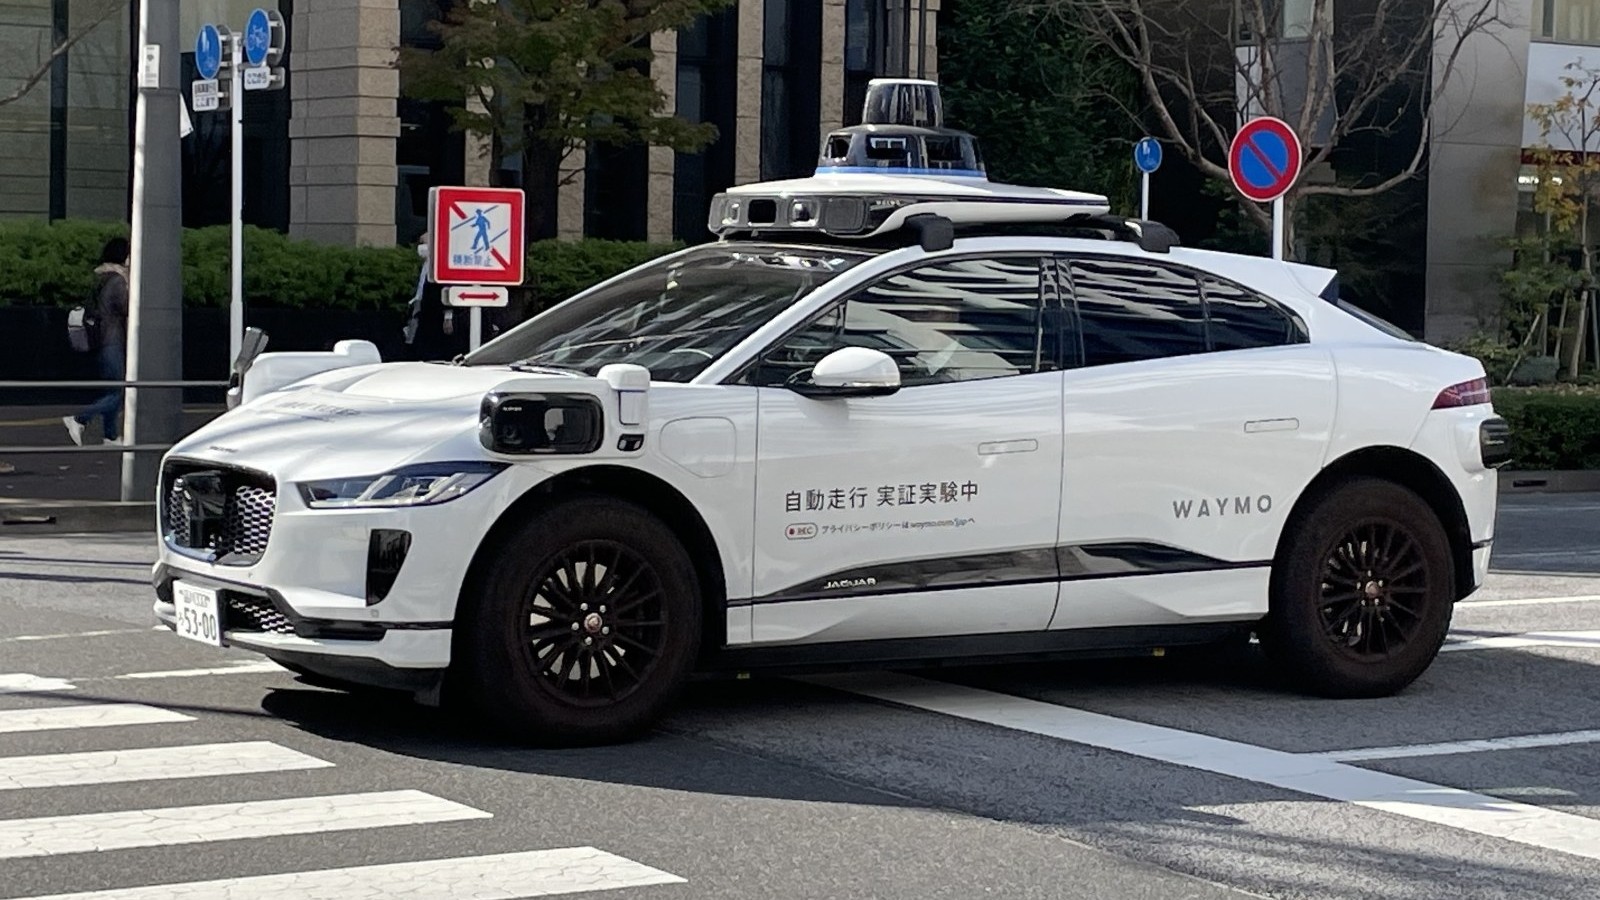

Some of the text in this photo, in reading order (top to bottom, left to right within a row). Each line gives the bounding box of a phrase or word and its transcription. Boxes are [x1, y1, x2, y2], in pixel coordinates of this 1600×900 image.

[453, 254, 493, 267] 横断禁止
[785, 480, 978, 513] 自動走行 実証実験中
[1173, 494, 1271, 519] WAYMO
[823, 577, 876, 589] JAGUAR
